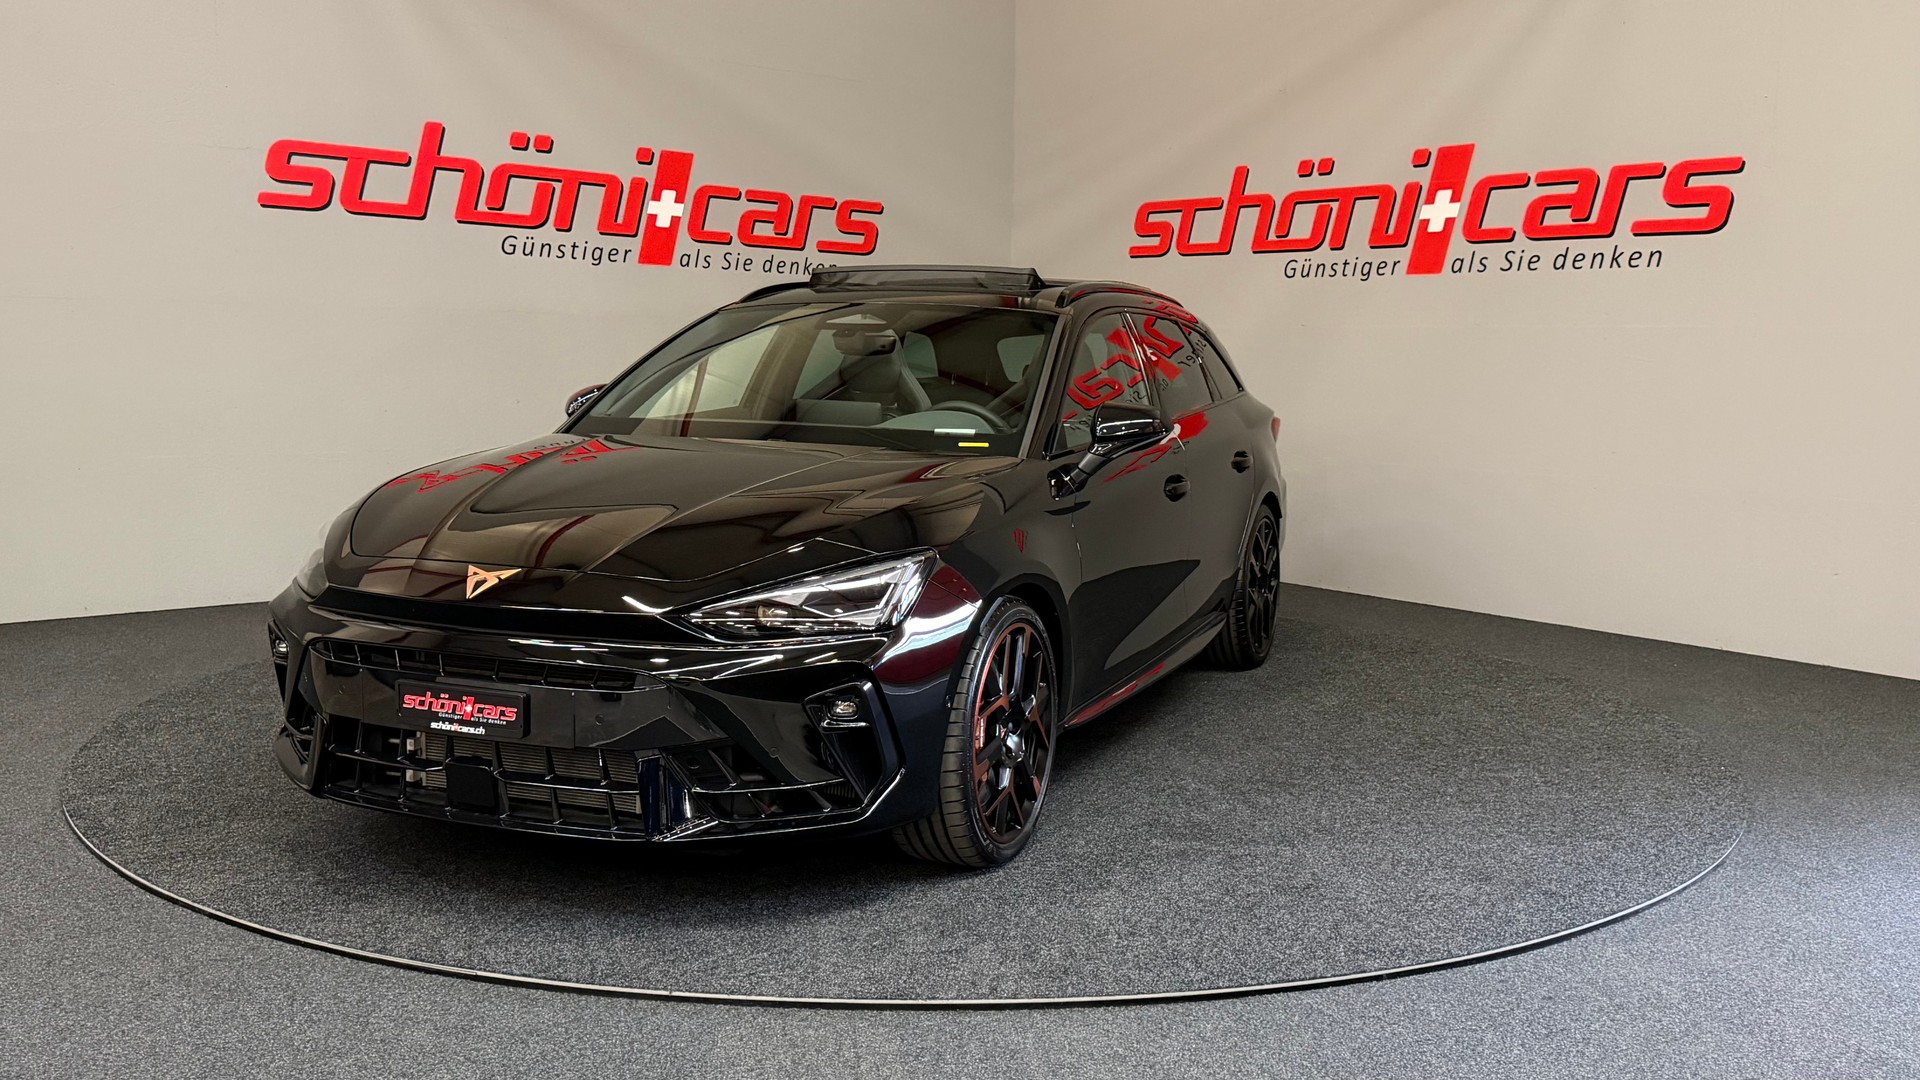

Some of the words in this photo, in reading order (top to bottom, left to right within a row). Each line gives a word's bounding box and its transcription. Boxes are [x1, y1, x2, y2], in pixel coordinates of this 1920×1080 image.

[501, 235, 633, 266] Günstiger
[679, 249, 712, 269] als
[721, 252, 754, 272] Sie
[1284, 256, 1401, 282] Günstiger
[1451, 251, 1489, 274] als
[1499, 249, 1541, 272] Sie
[1553, 245, 1663, 271] denken
